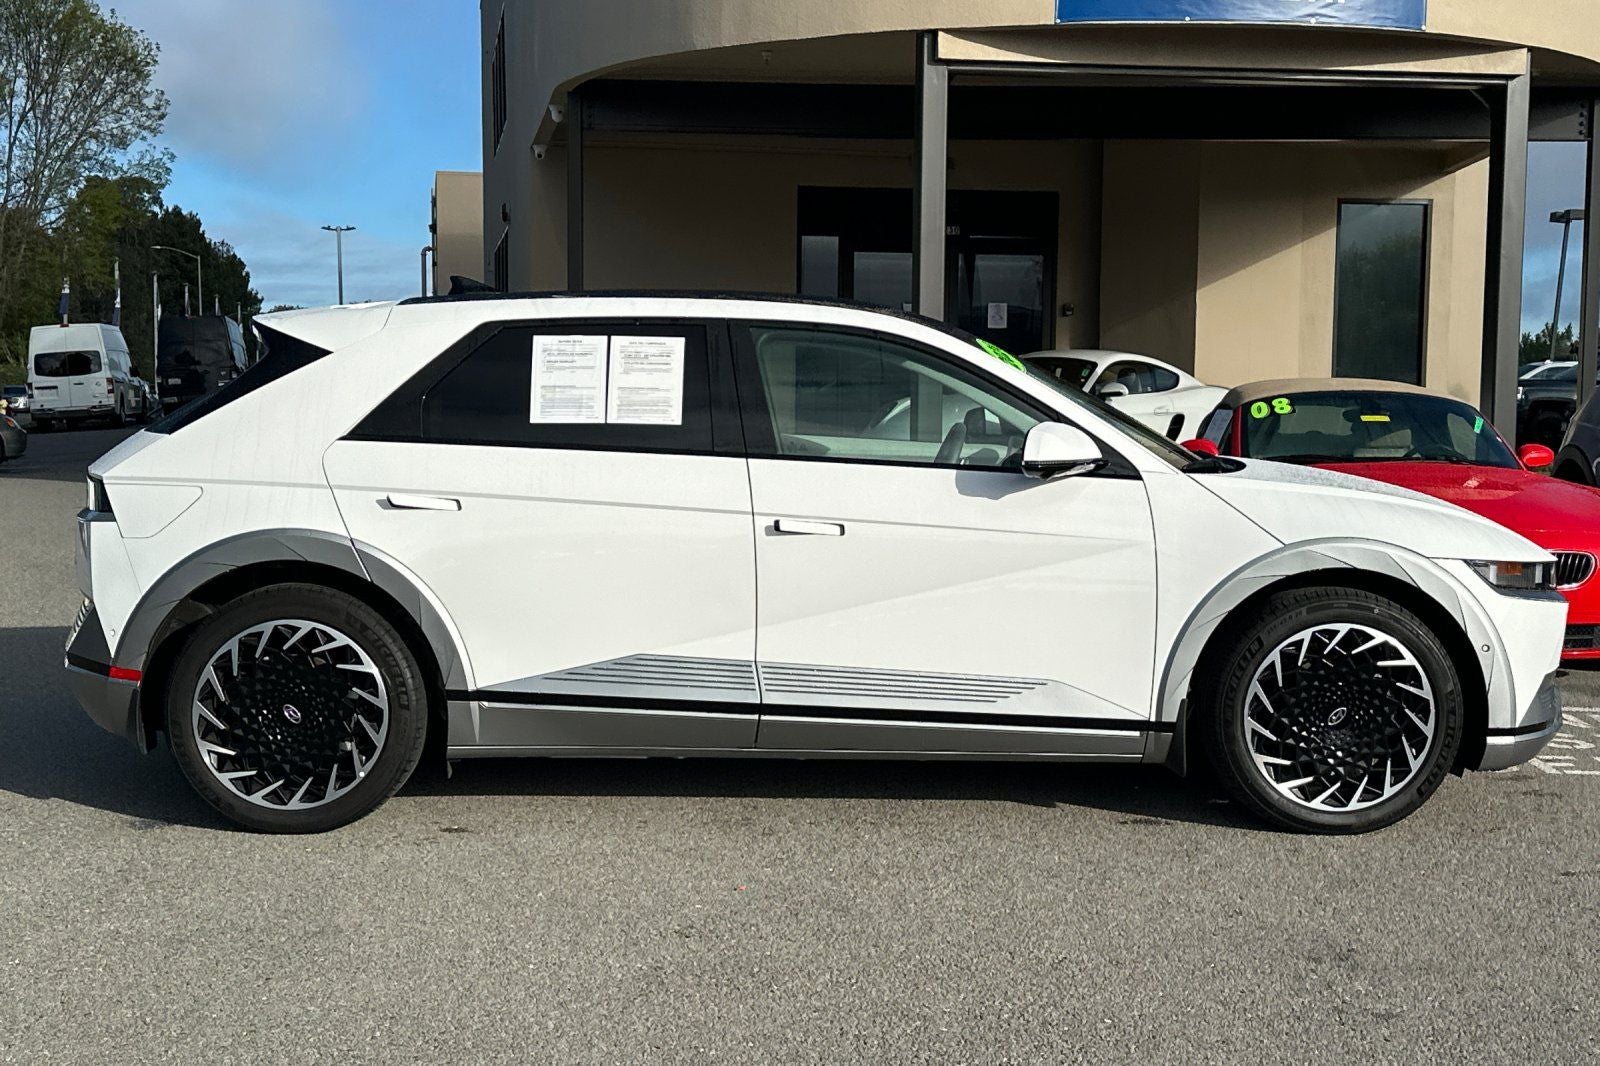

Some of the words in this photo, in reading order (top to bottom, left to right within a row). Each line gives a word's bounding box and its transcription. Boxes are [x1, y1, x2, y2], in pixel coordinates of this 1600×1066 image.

[1251, 398, 1292, 419] 08
[364, 627, 409, 706] MICHELIN
[1224, 638, 1262, 720] MICHELIN
